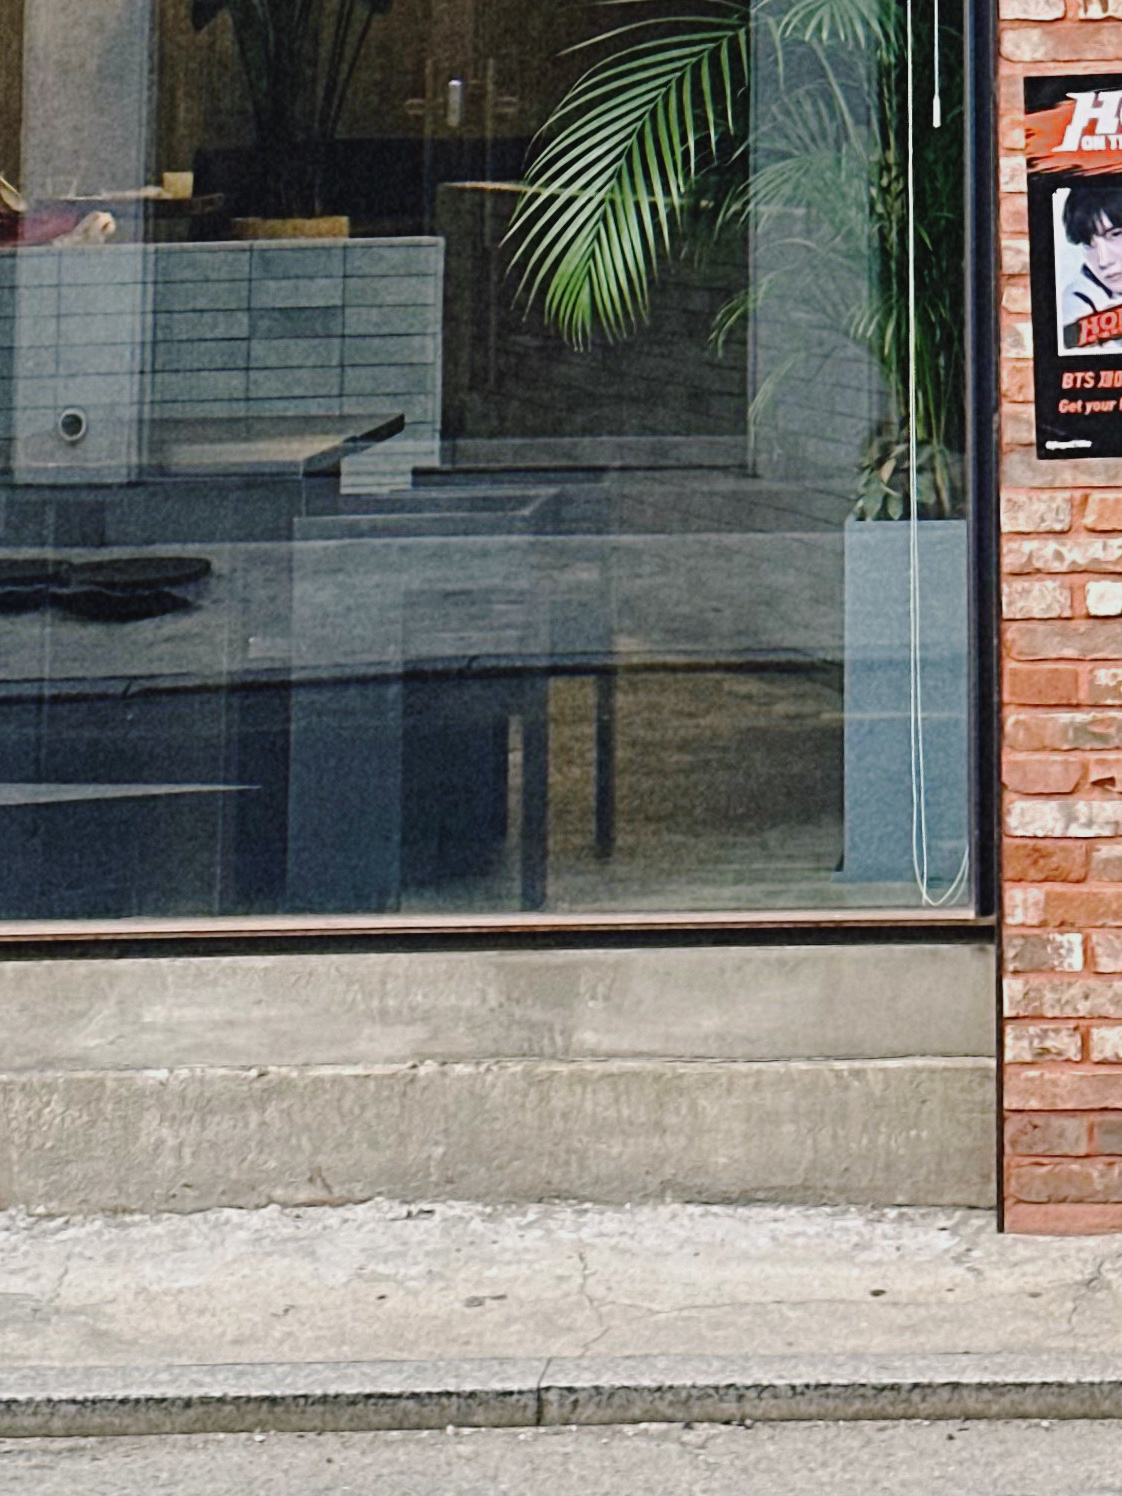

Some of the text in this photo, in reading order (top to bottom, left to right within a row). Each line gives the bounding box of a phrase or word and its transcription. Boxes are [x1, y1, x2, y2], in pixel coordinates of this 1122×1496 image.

[1081, 135, 1106, 151] ON
[1061, 371, 1095, 389] BTS
[1058, 399, 1083, 414] Get
[1084, 399, 1117, 416] your
